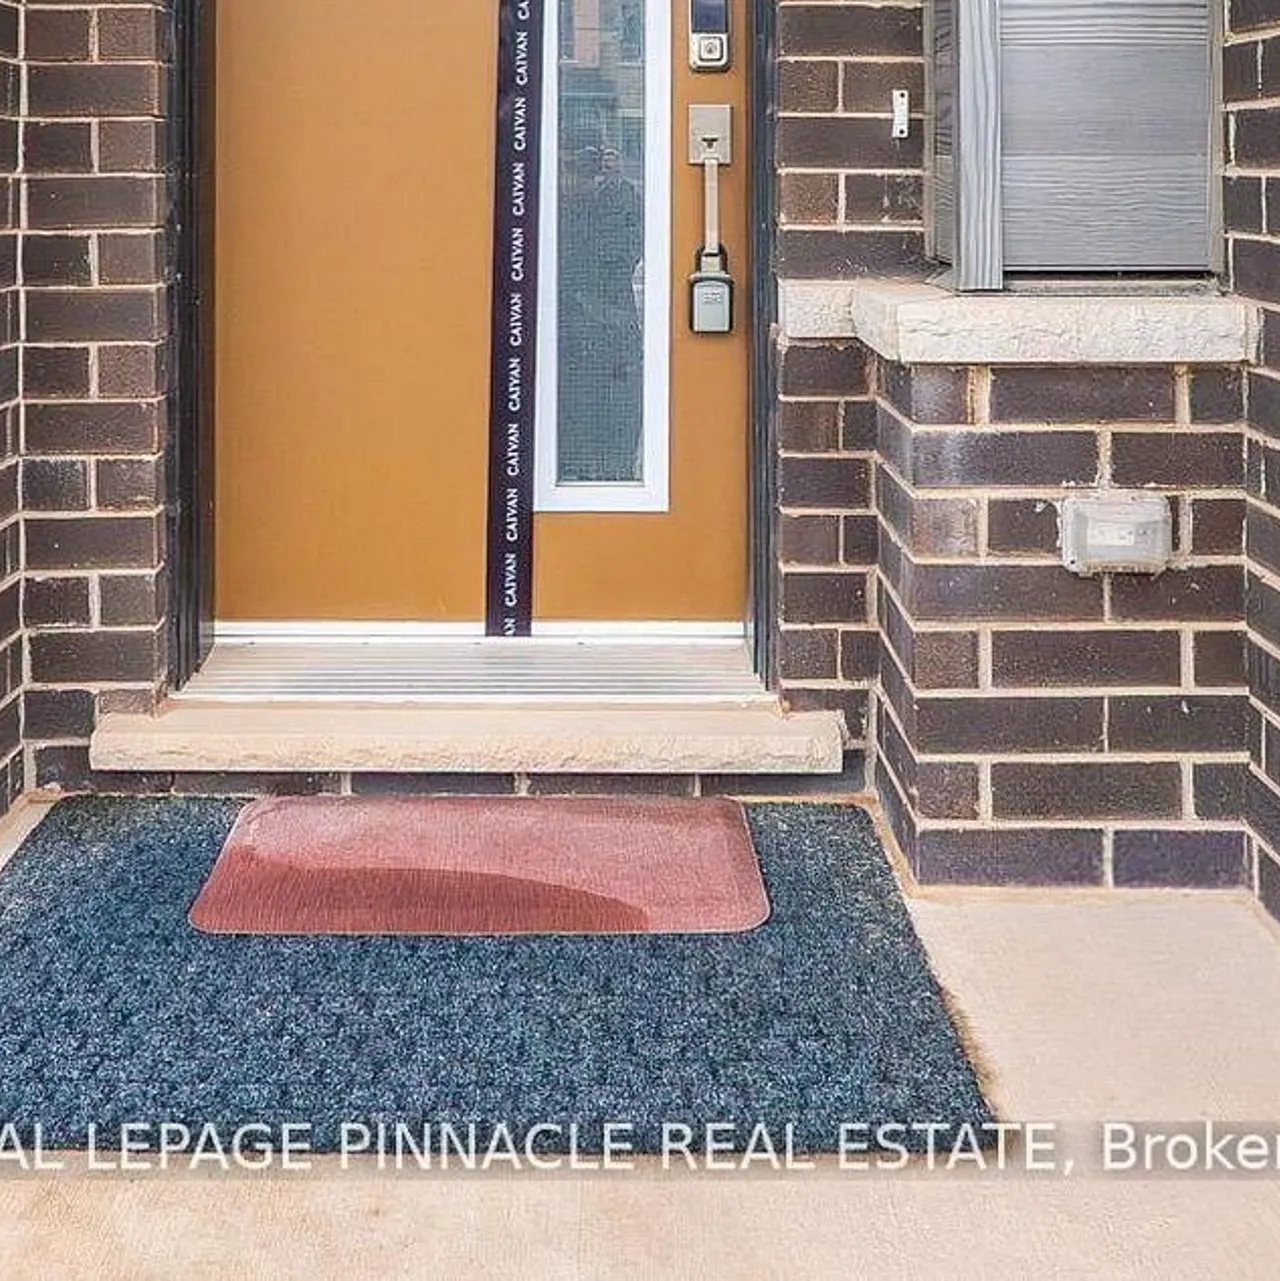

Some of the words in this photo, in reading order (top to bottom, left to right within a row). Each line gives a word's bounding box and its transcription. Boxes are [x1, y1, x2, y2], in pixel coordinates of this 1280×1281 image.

[515, 31, 529, 86] CAIVAN
[513, 96, 527, 152] CAIVAN
[512, 162, 526, 217] CAIVAN
[510, 227, 524, 282] CAIVAN
[509, 292, 523, 347] CAIVAN
[508, 357, 521, 412] CAIVAN
[506, 423, 520, 477] CAIVAN
[505, 488, 519, 542] CAIVAN
[504, 552, 517, 608] CAIVAN
